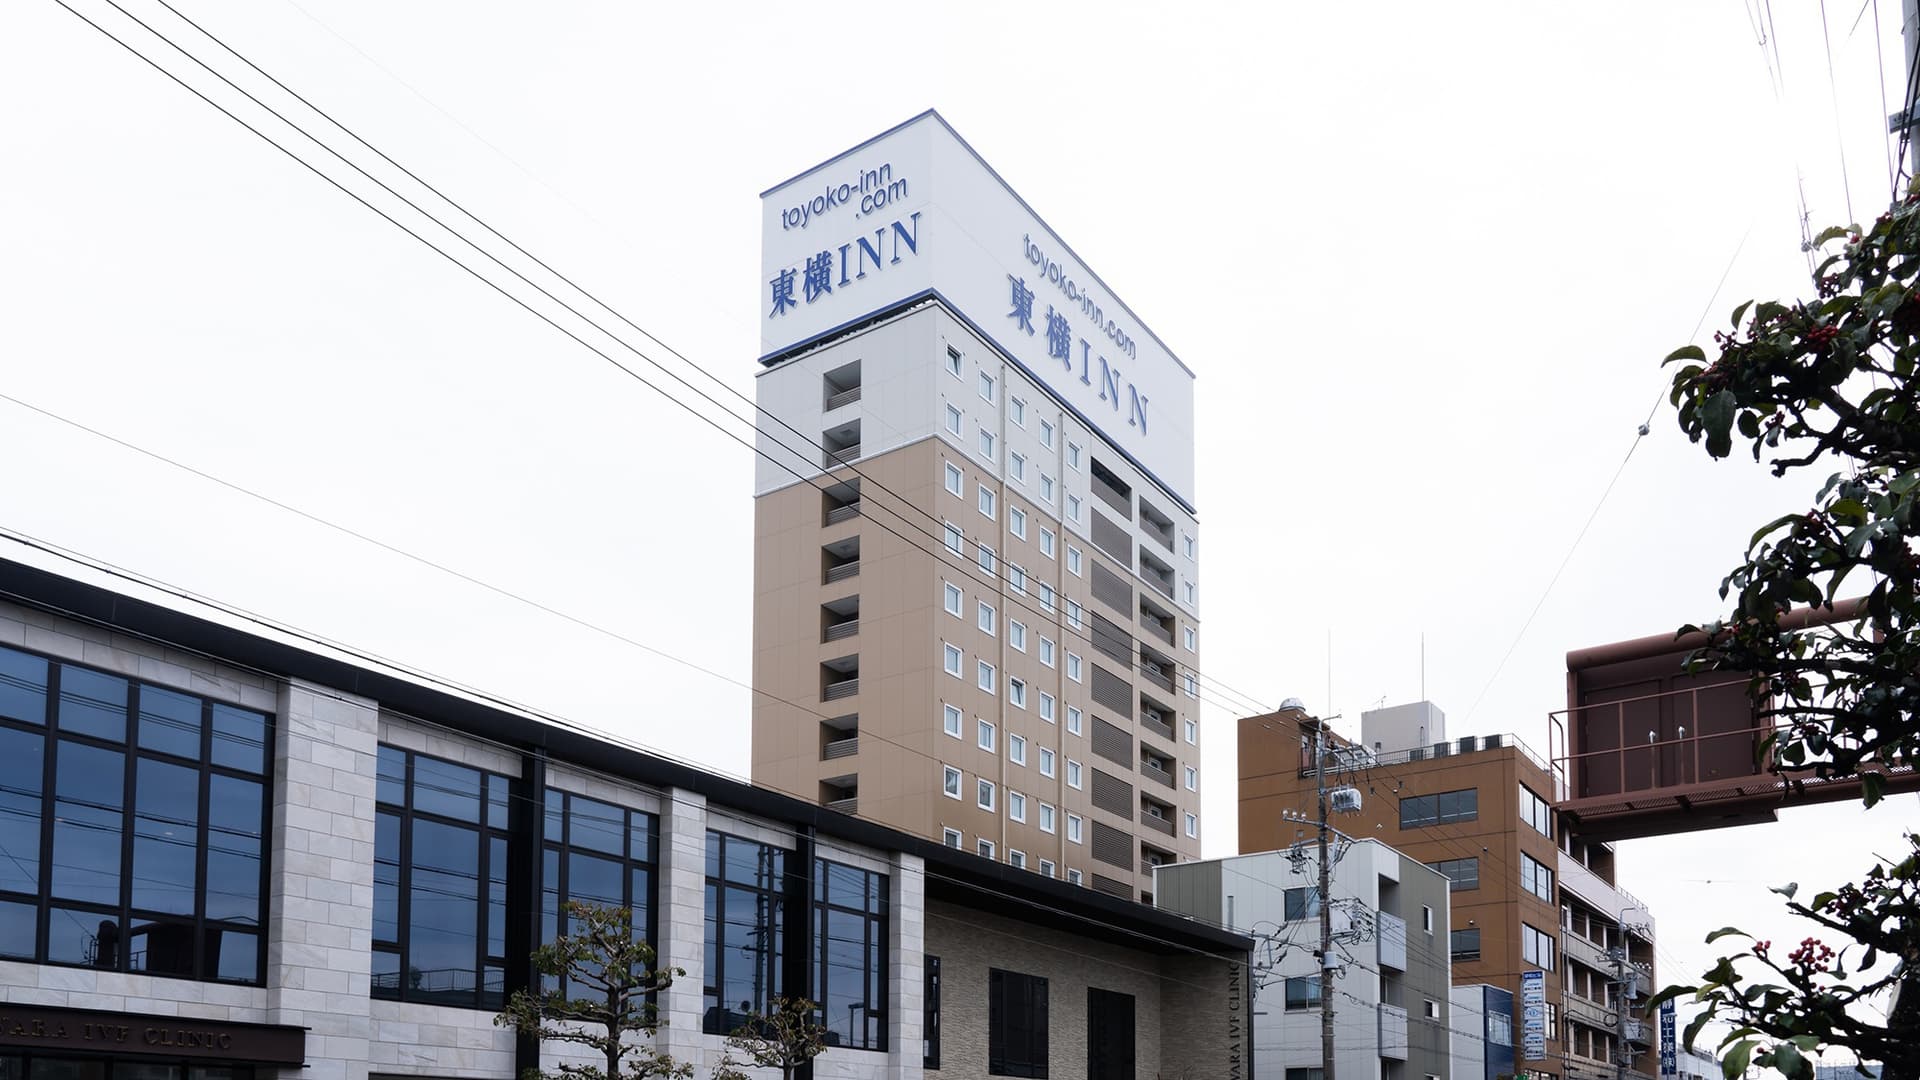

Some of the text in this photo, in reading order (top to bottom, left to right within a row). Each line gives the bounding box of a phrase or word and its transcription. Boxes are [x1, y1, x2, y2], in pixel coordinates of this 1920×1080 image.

[781, 161, 892, 230] toyoko-inn
[769, 212, 922, 319] 東横INN
[1023, 232, 1137, 360] toyoko-inn.com
[1006, 273, 1151, 436] 東横INN
[1229, 961, 1240, 1011] CLINIC
[84, 1023, 129, 1043] IVF
[144, 1027, 233, 1049] CLINIC
[1229, 1016, 1240, 1038] IVF
